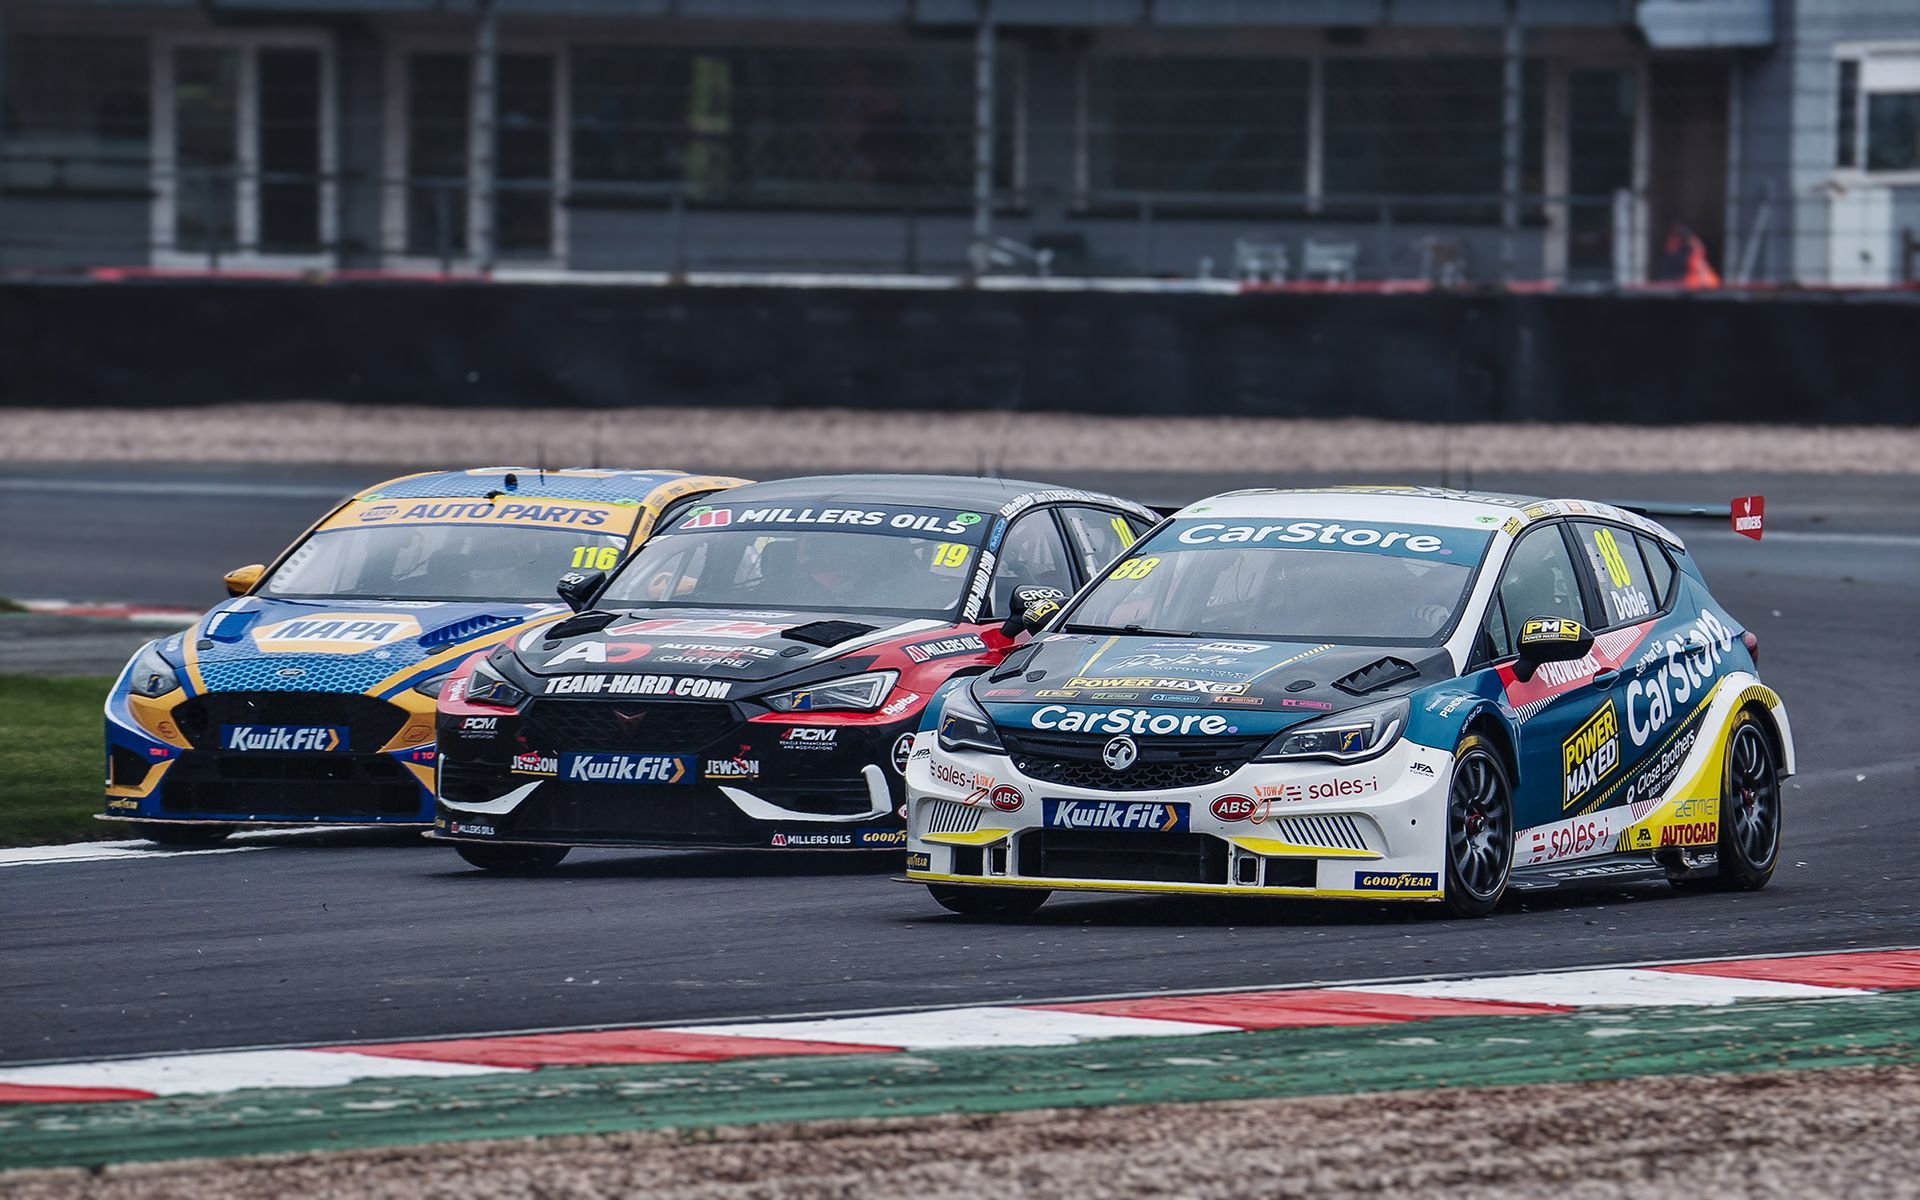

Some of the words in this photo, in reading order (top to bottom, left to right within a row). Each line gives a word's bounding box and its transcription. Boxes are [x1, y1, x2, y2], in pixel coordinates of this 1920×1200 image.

[400, 503, 496, 520] AUTO
[499, 504, 609, 526] PARTS
[736, 507, 890, 526] MILLERS
[889, 513, 967, 535] OILS
[570, 545, 620, 571] 116
[932, 542, 970, 568] 19
[1593, 528, 1631, 589] 88
[1108, 557, 1161, 581] 88
[1019, 589, 1065, 601] ERGO
[1610, 585, 1650, 621] Doble
[273, 620, 400, 642] NAPA
[1526, 620, 1578, 635] PMR
[920, 640, 965, 657] MILLERS
[962, 635, 986, 650] OILS
[699, 656, 752, 668] CARE
[544, 674, 732, 700] TEAM-HARD.COM
[1067, 677, 1154, 688] POWER
[1155, 679, 1244, 695] MAXED
[881, 693, 920, 715] Digital
[463, 717, 498, 730] PCM
[789, 727, 837, 741] PCM
[1565, 710, 1616, 775] POWER
[510, 755, 558, 773] JEWSON
[704, 759, 760, 775] JEWSON
[1409, 761, 1434, 775] JFA
[1566, 737, 1617, 802] MAXED
[1637, 763, 1661, 795] Close
[1661, 729, 1695, 774] Brothers
[936, 764, 976, 790] sales-i
[1308, 775, 1379, 800] sales-i
[995, 791, 1020, 805] ABS
[1262, 786, 1278, 797] TOW
[1217, 801, 1252, 814] ABS
[787, 834, 830, 845] MILLERS
[829, 834, 852, 844] OILS
[1636, 828, 1652, 841] JFA
[1660, 821, 1717, 846] AUTOCAR
[1362, 873, 1433, 889] GOODYEAR
